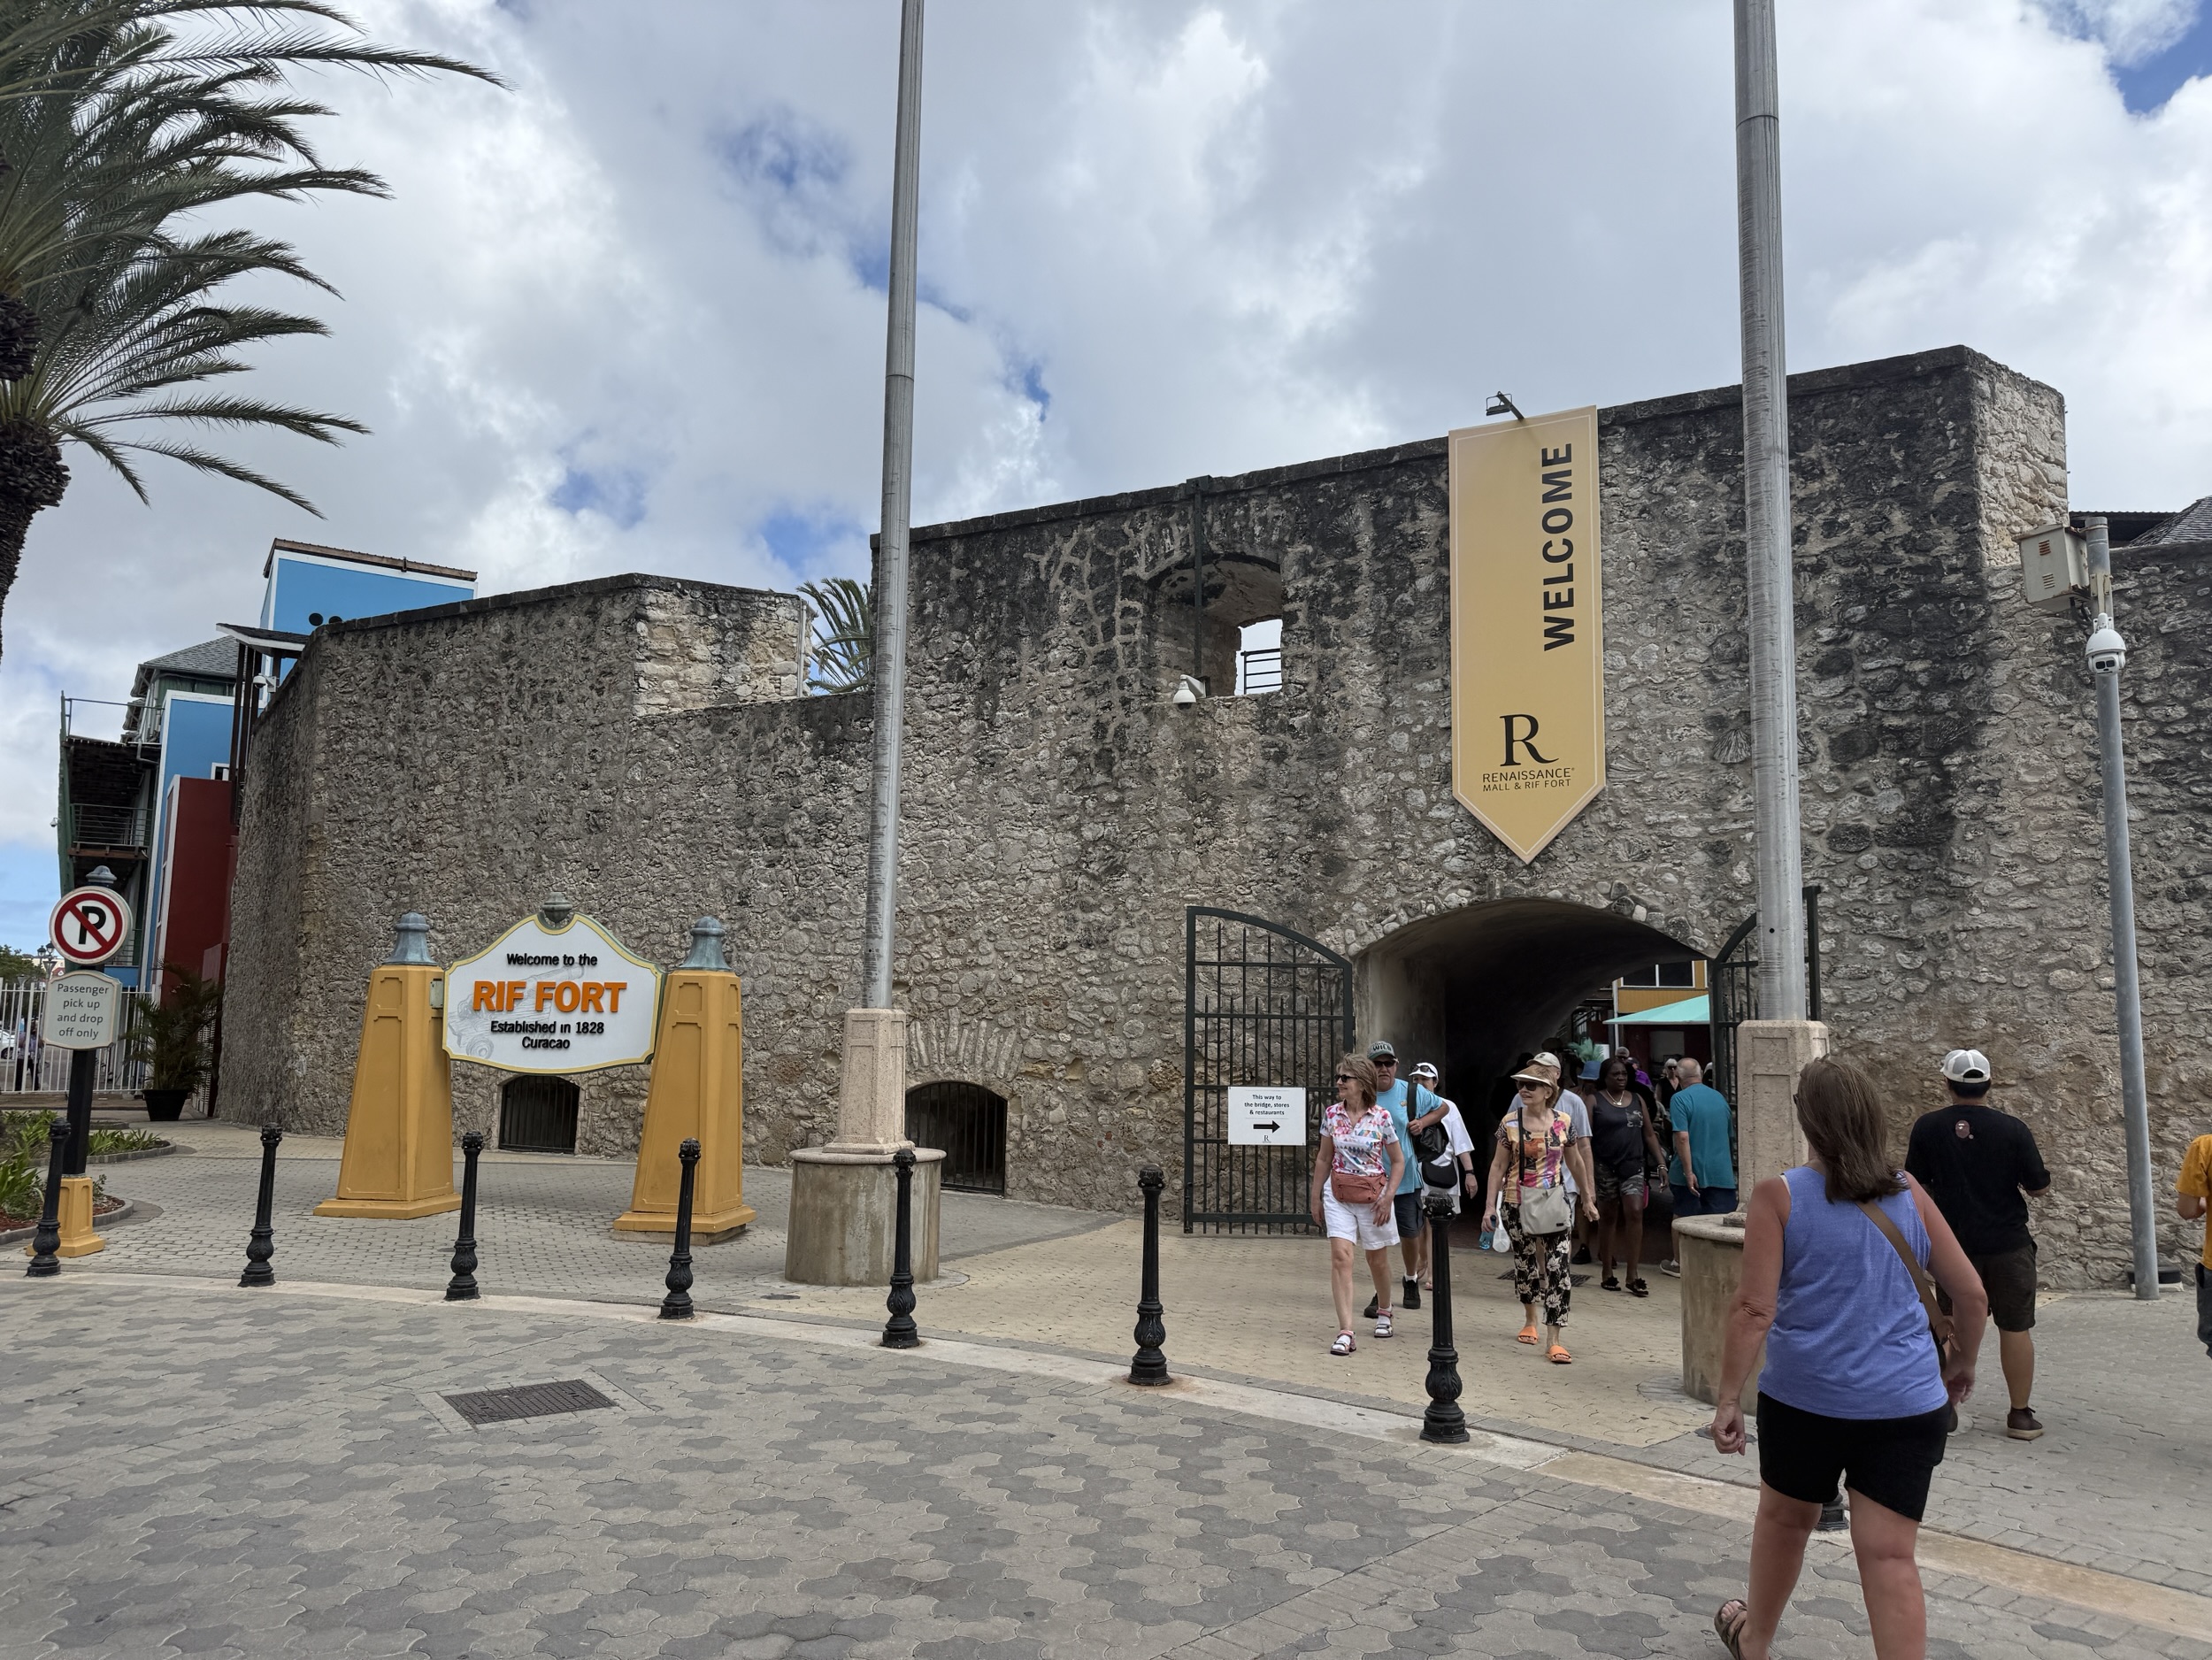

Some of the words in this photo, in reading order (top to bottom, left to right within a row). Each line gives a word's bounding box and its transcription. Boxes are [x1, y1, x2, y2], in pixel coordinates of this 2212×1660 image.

[1541, 443, 1575, 651] WELCOME
[1499, 713, 1560, 767] R
[1483, 783, 1510, 792] MALL
[1525, 780, 1540, 789] RIF
[1544, 779, 1571, 788] FORT
[506, 953, 560, 965] Welcome
[563, 954, 575, 965] to
[578, 954, 598, 966] the
[57, 983, 110, 996] Passenger
[472, 980, 526, 1012] RIF
[534, 980, 627, 1013] FORT
[63, 998, 84, 1009] pick
[57, 1012, 77, 1022] and
[79, 1013, 104, 1025] drop
[490, 1020, 557, 1034] Established
[560, 1023, 572, 1034] in
[576, 1022, 604, 1034] 1828
[58, 1027, 74, 1037] off
[76, 1028, 99, 1041] only
[521, 1036, 571, 1049] Curacao
